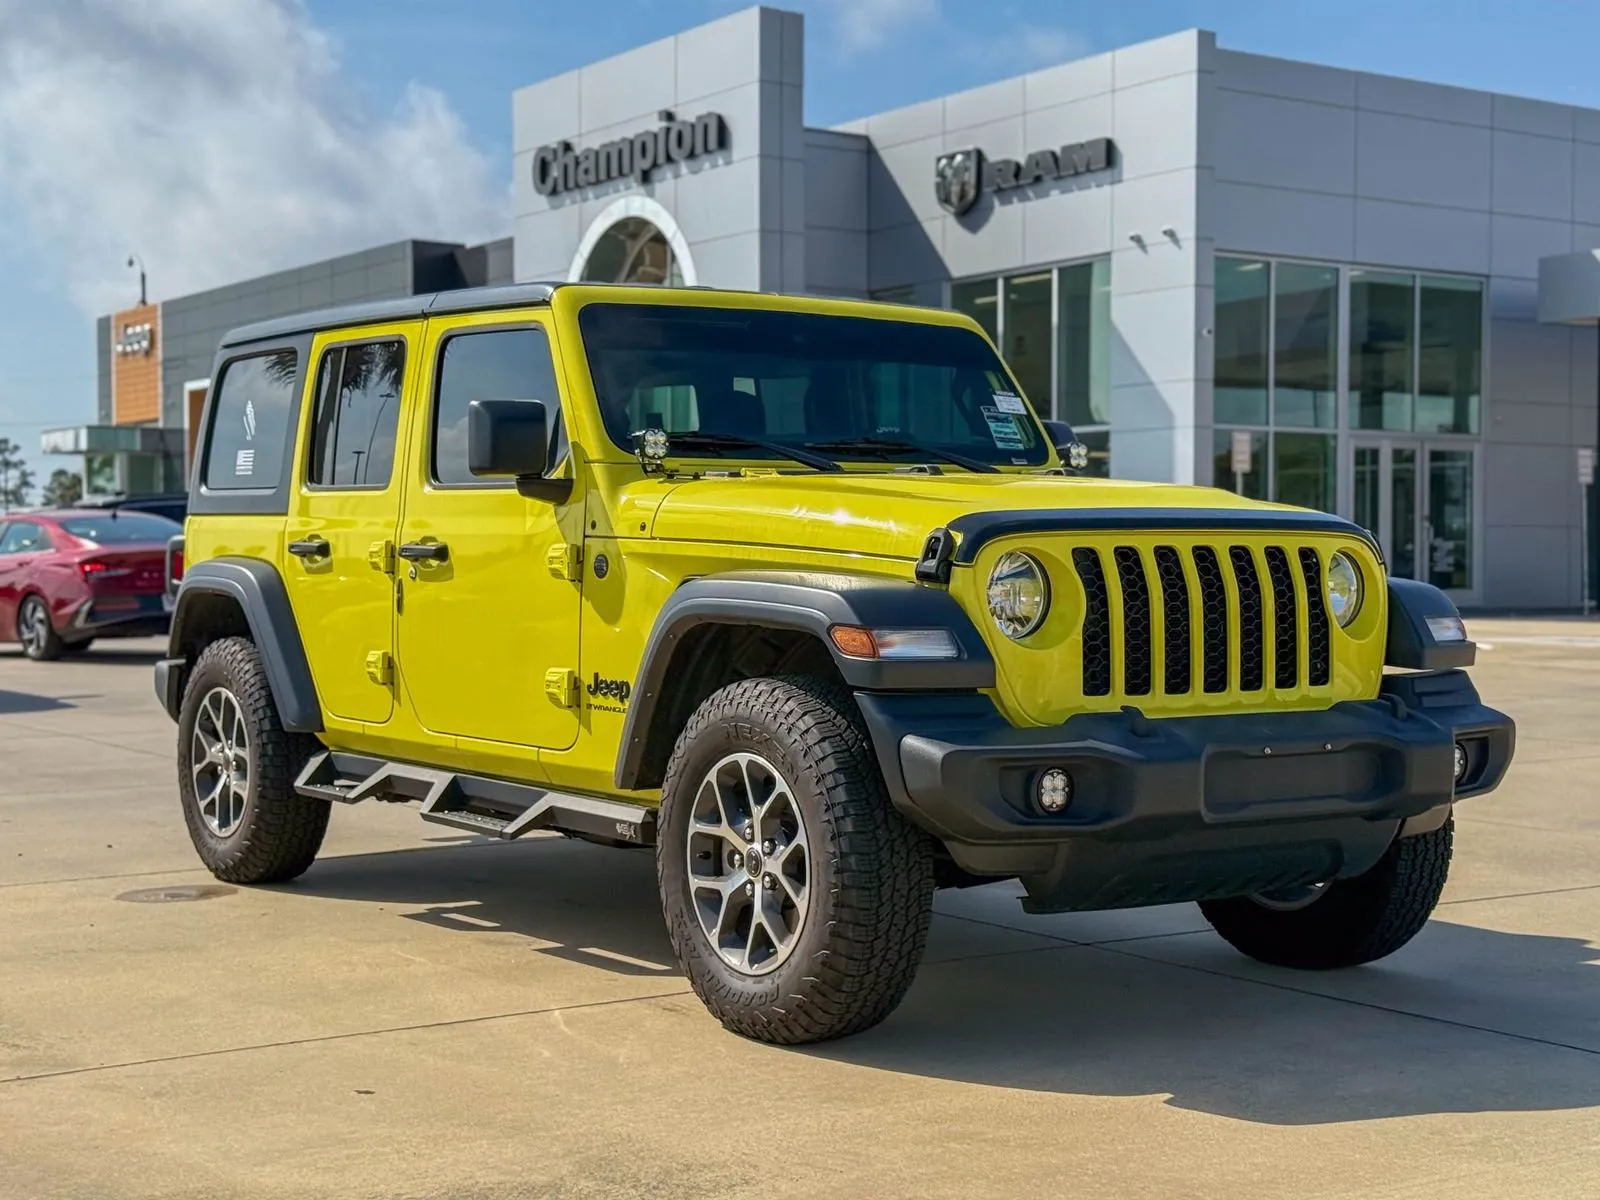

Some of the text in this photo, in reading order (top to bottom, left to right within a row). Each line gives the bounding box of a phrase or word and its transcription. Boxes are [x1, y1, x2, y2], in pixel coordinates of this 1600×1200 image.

[533, 108, 727, 196] Champion
[982, 138, 1111, 192] RAM
[586, 672, 631, 704] Jeep
[592, 703, 627, 714] WRANGLE
